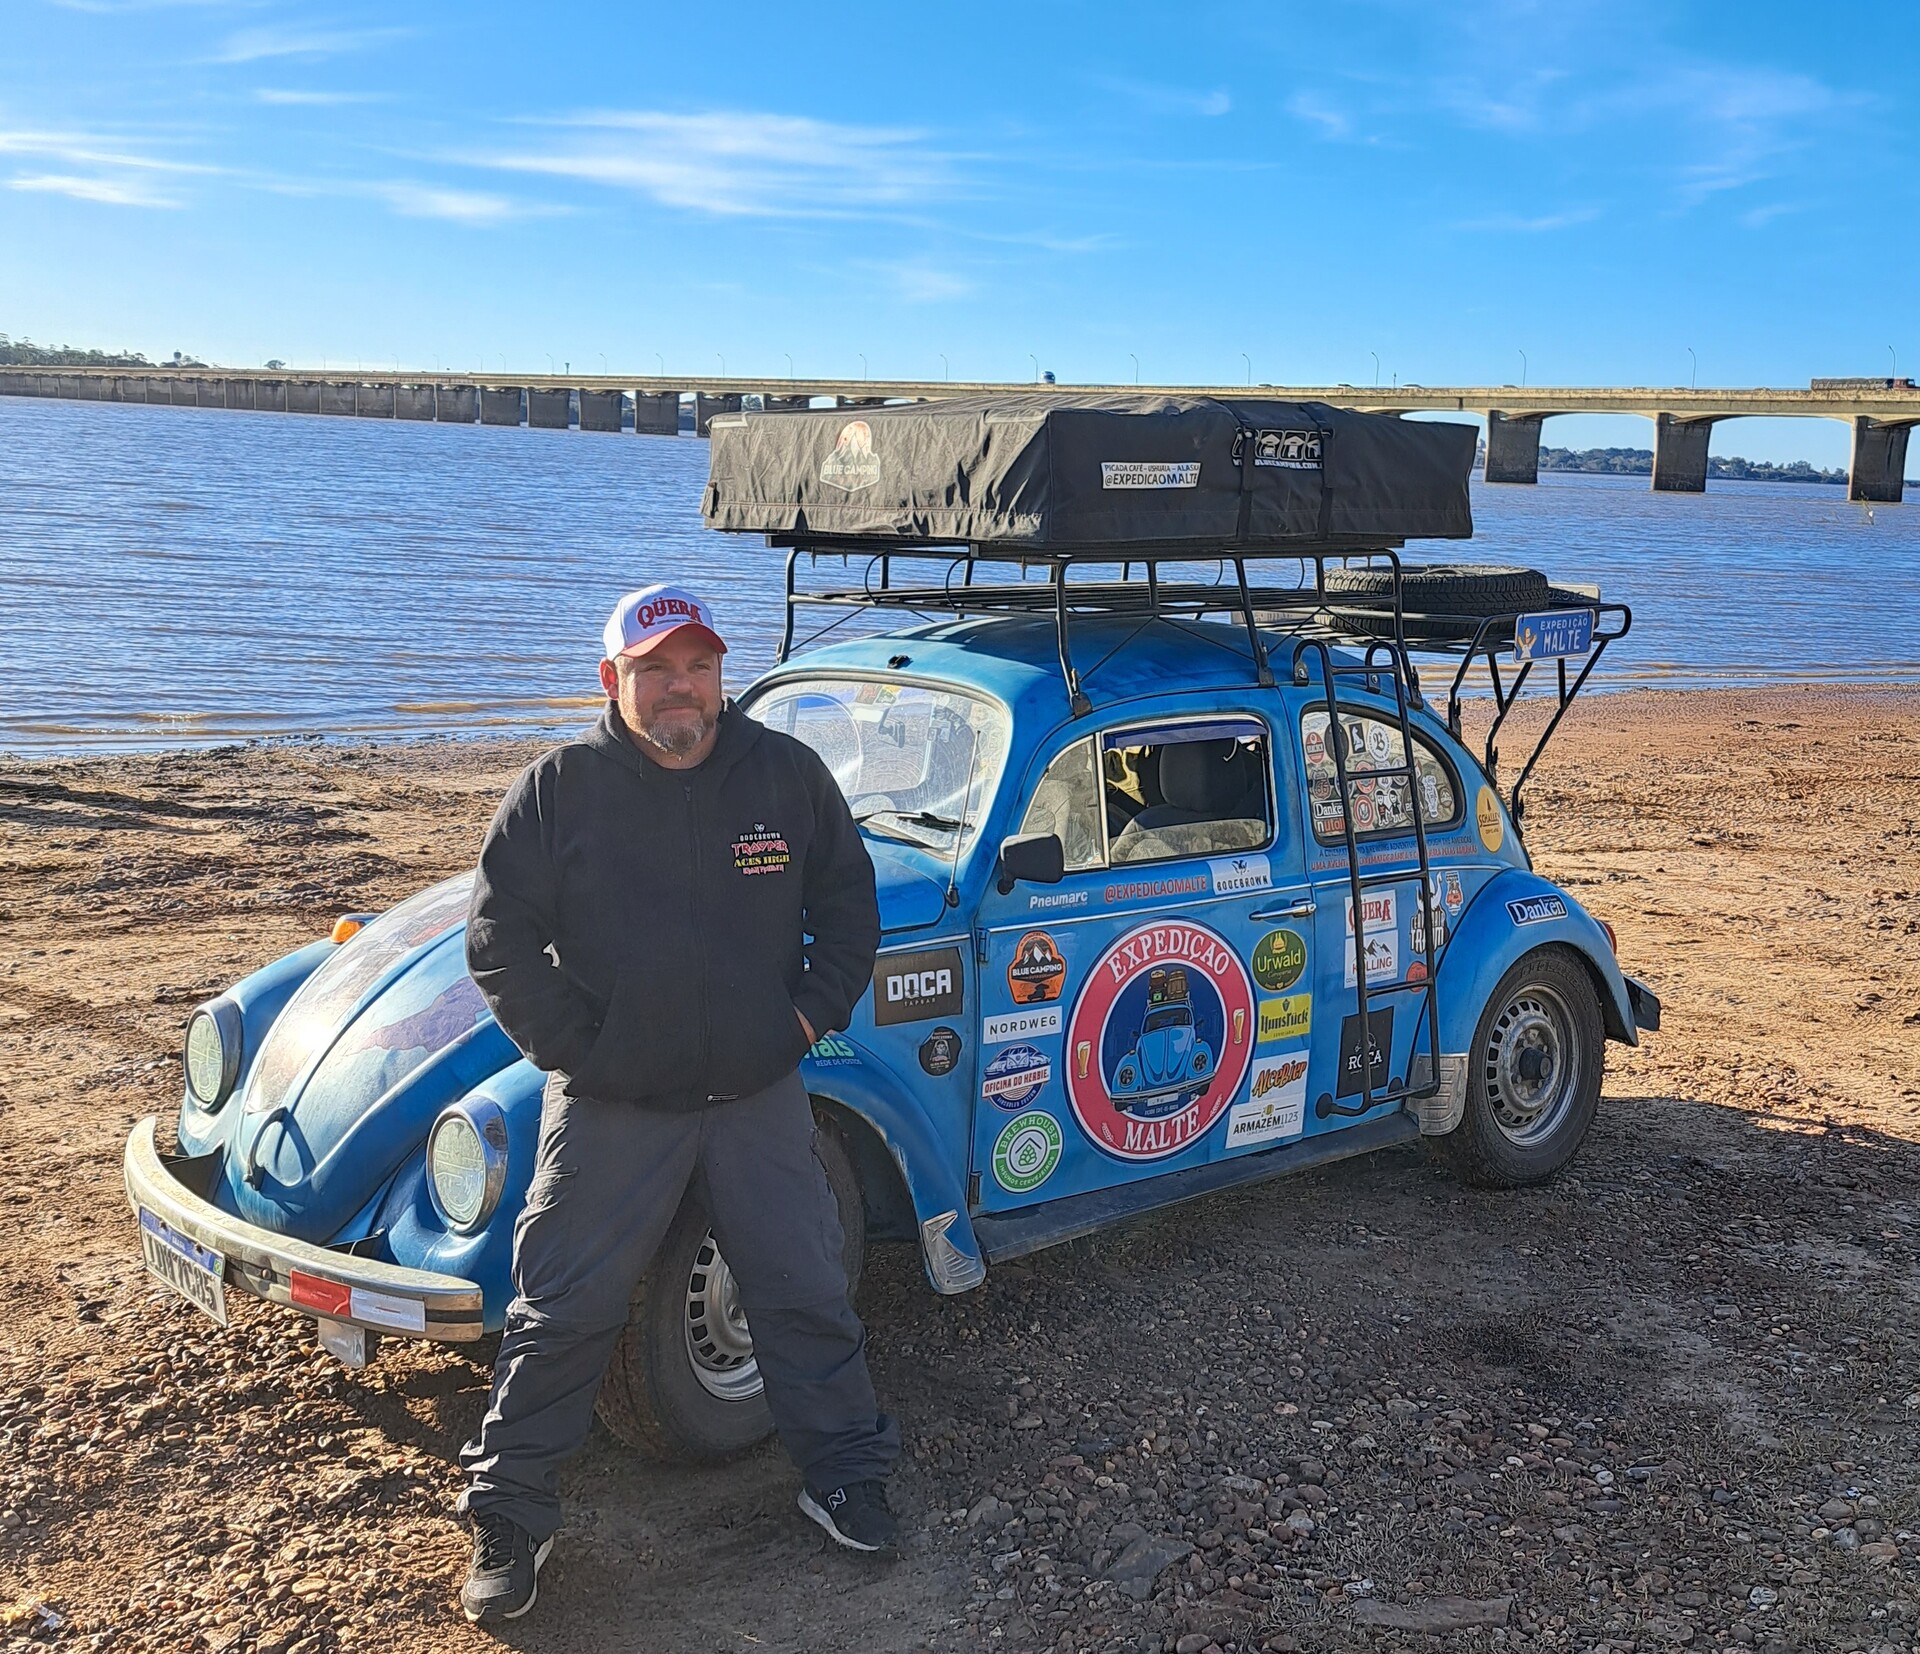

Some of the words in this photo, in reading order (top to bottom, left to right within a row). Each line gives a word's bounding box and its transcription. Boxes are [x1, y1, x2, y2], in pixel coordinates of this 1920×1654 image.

[1104, 464, 1128, 472] PICADA
[1540, 615, 1588, 630] EXPEDIÇÃO
[1543, 629, 1582, 654] MALTE
[1315, 802, 1344, 817] Danke
[733, 856, 762, 867] ACES
[1105, 876, 1206, 902] @EXPEDICAOMALTE
[1216, 875, 1269, 891] BODEBROWN
[1029, 891, 1088, 909] Pneumarc
[1510, 898, 1566, 922] Danken
[1257, 949, 1301, 972] Urwald
[1012, 967, 1029, 977] BLUE
[1030, 964, 1062, 975] CAMPING
[886, 969, 952, 1001] DOCA
[990, 1016, 1057, 1035] NORDWEG
[985, 1077, 1011, 1093] OFICINA
[1013, 1075, 1023, 1086] DO
[1000, 1116, 1058, 1149] BREWHOUSE
[1122, 1105, 1201, 1151] MALTE
[1000, 1164, 1018, 1185] INSUMOS
